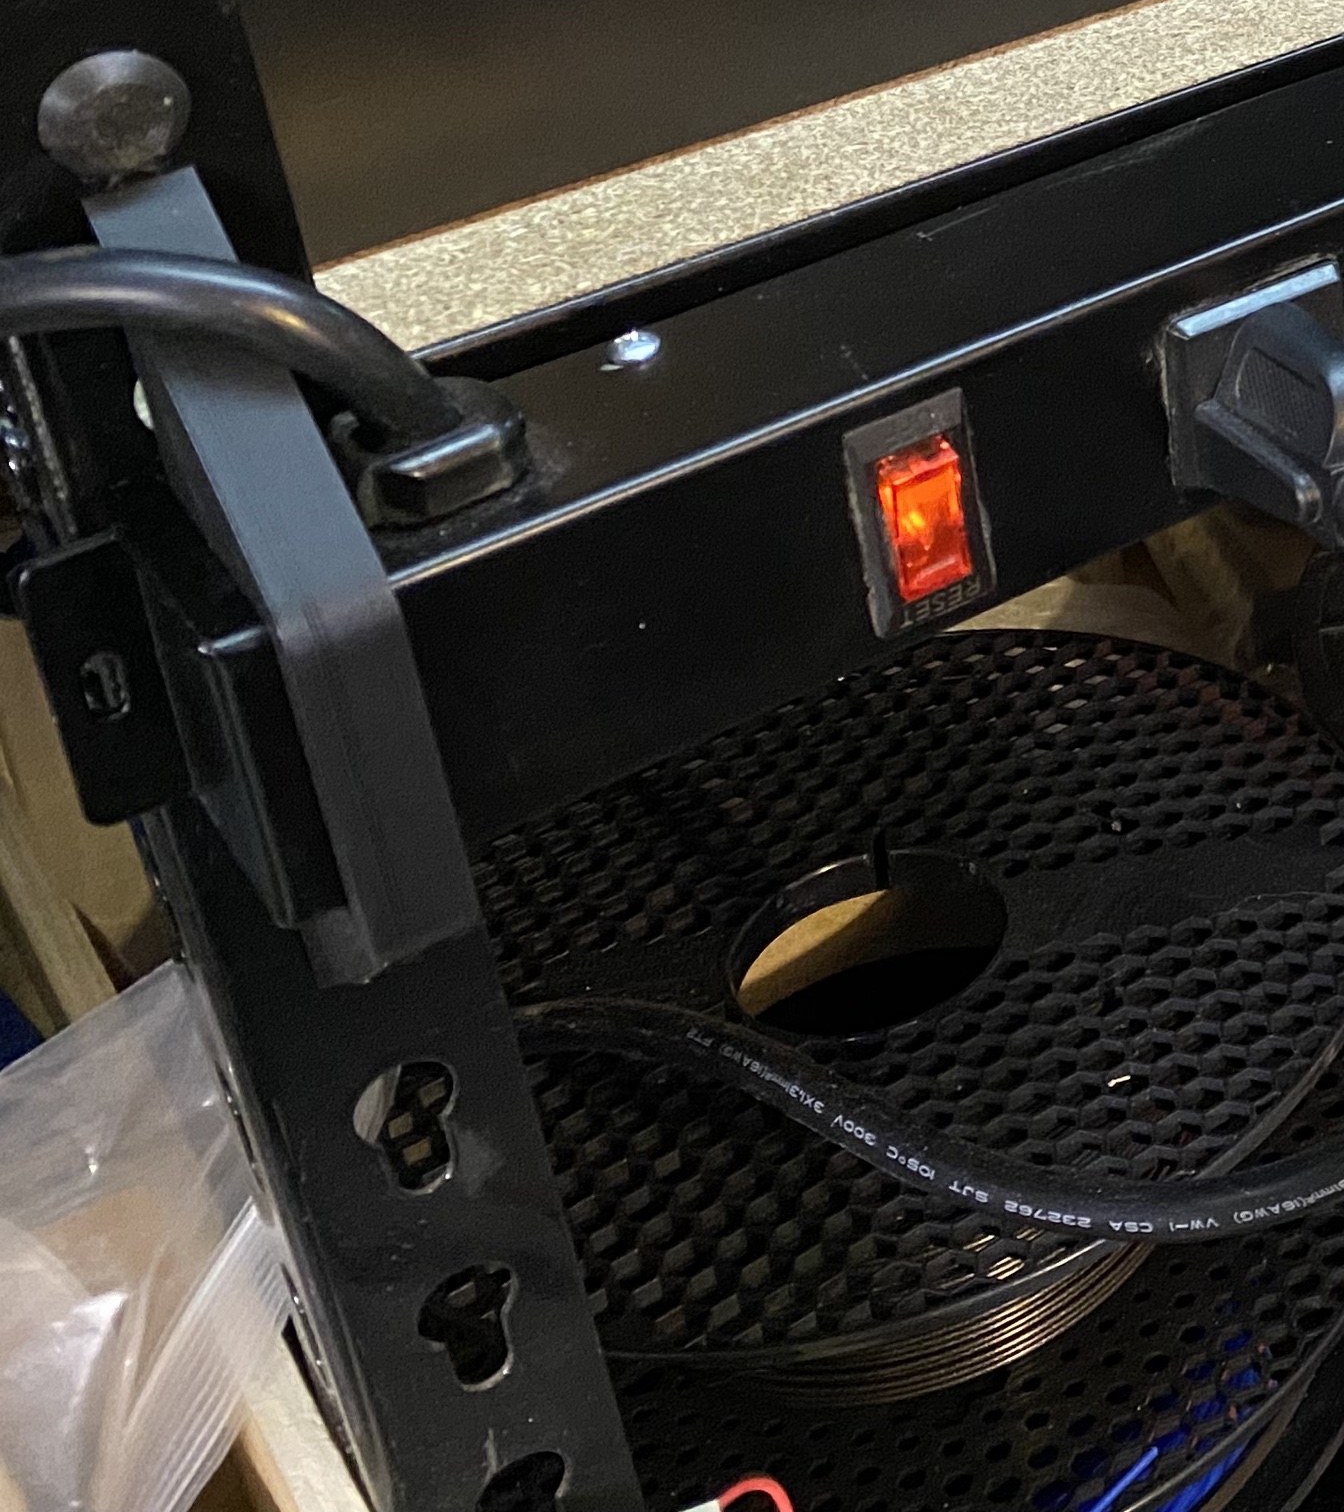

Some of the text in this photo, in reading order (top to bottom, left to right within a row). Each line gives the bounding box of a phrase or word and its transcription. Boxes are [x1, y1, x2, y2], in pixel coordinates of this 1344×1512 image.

[899, 574, 980, 629] RESET
[830, 1113, 878, 1147] 300V
[947, 1179, 990, 1204] SJT
[1003, 1199, 1093, 1229] 232762
[1107, 1219, 1154, 1234] CSA
[1168, 1216, 1220, 1233] VW-1
